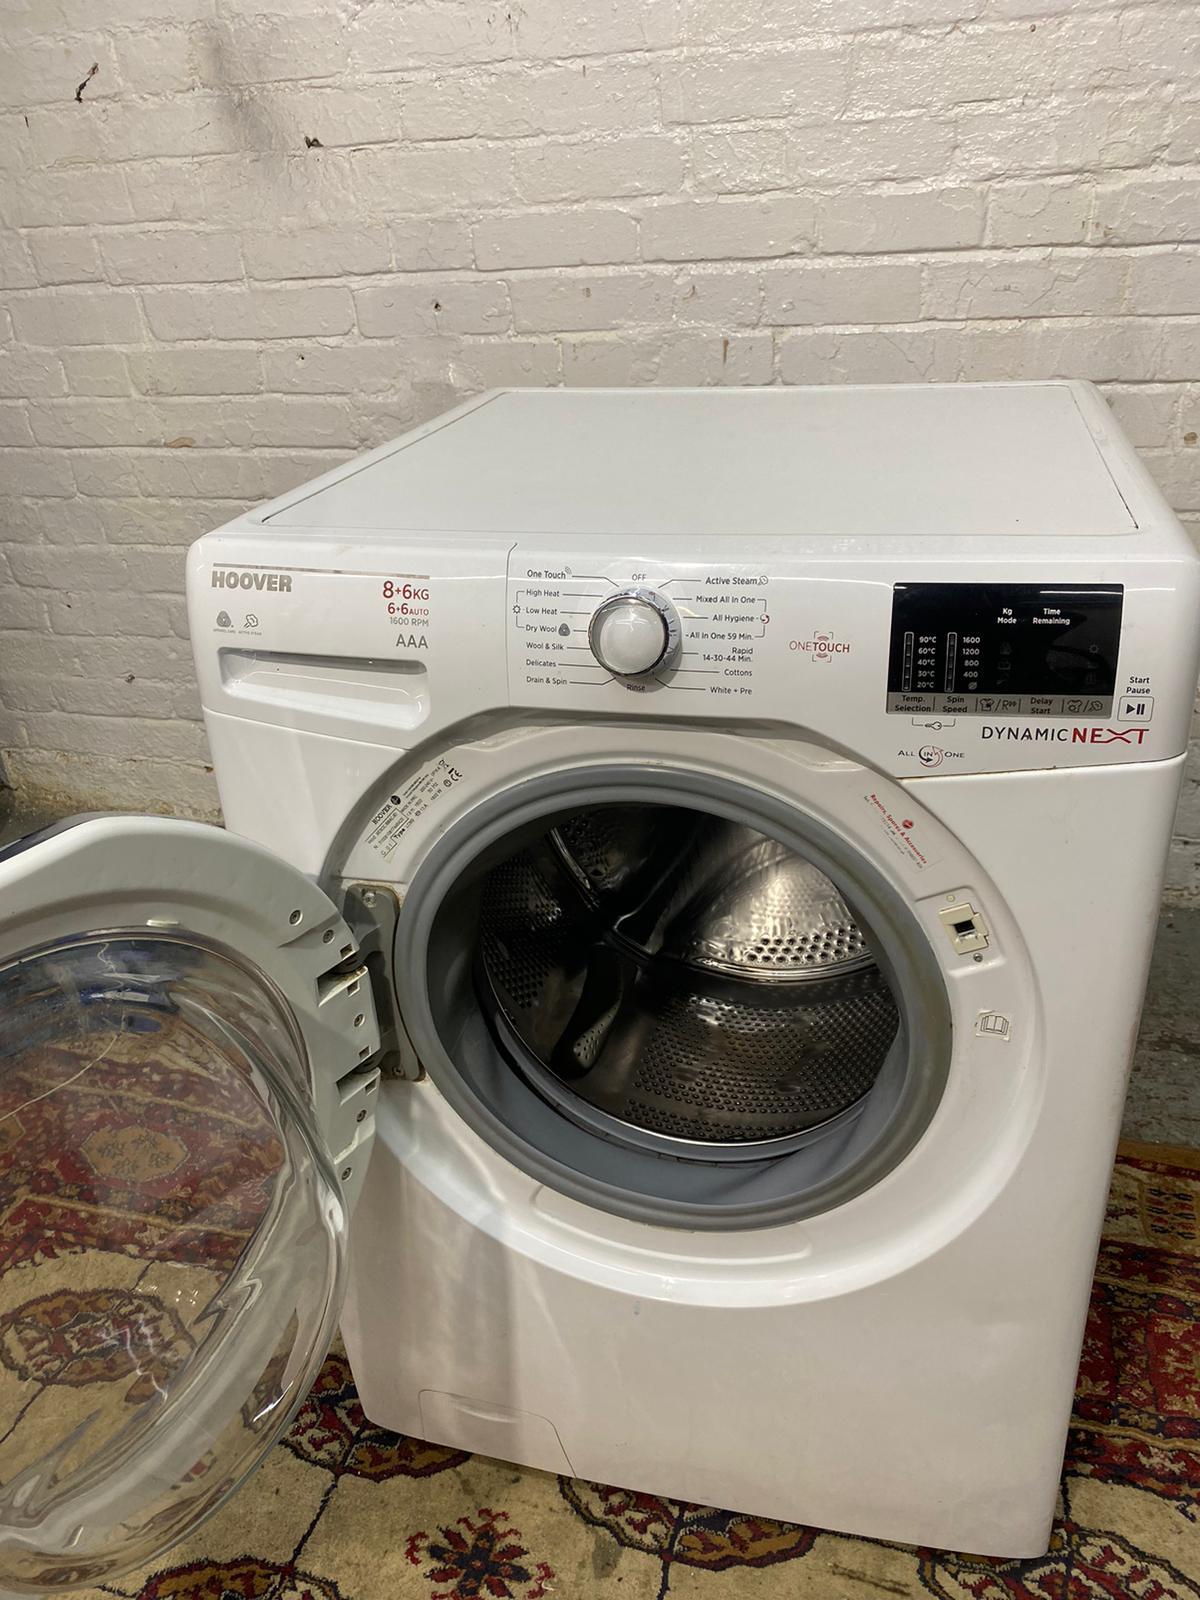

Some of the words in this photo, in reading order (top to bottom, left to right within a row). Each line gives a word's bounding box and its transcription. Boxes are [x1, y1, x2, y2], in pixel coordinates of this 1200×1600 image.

[527, 570, 542, 578] One
[544, 570, 566, 579] Touch
[632, 573, 647, 581] OFF
[211, 571, 293, 592] HOOVER
[705, 577, 731, 585] Active
[733, 577, 757, 585] Steam
[382, 580, 429, 600] 8+6KG
[526, 589, 542, 598] High
[543, 589, 559, 597] Heat
[696, 595, 718, 604] Mixed
[720, 596, 730, 604] All
[731, 596, 739, 604] In
[740, 596, 756, 604] One
[1002, 608, 1013, 616] Kg
[390, 616, 409, 626] 1600
[411, 618, 429, 627] RPM
[712, 614, 723, 622] All
[724, 615, 755, 624] Hygiene
[1032, 617, 1071, 626] Remaining
[689, 632, 700, 640] All
[701, 632, 709, 640] In
[710, 632, 725, 640] One
[727, 632, 737, 640] 59
[738, 632, 754, 640] Min.
[963, 636, 981, 644] 1600
[395, 633, 429, 649] AAA
[552, 642, 564, 650] Silk
[731, 647, 753, 655] Rapid
[918, 647, 936, 655] 60°C
[526, 659, 556, 667] Delicates
[724, 669, 753, 677] Cottons
[526, 676, 544, 684] Drain
[552, 677, 568, 686] Spin
[1129, 676, 1150, 684] Start
[626, 683, 646, 691] Rinse
[710, 686, 732, 694] White
[740, 687, 753, 695] Pre
[946, 696, 965, 704] Spin
[1030, 697, 1053, 705] Delay
[894, 705, 931, 713] Selection
[942, 705, 968, 713] Speed
